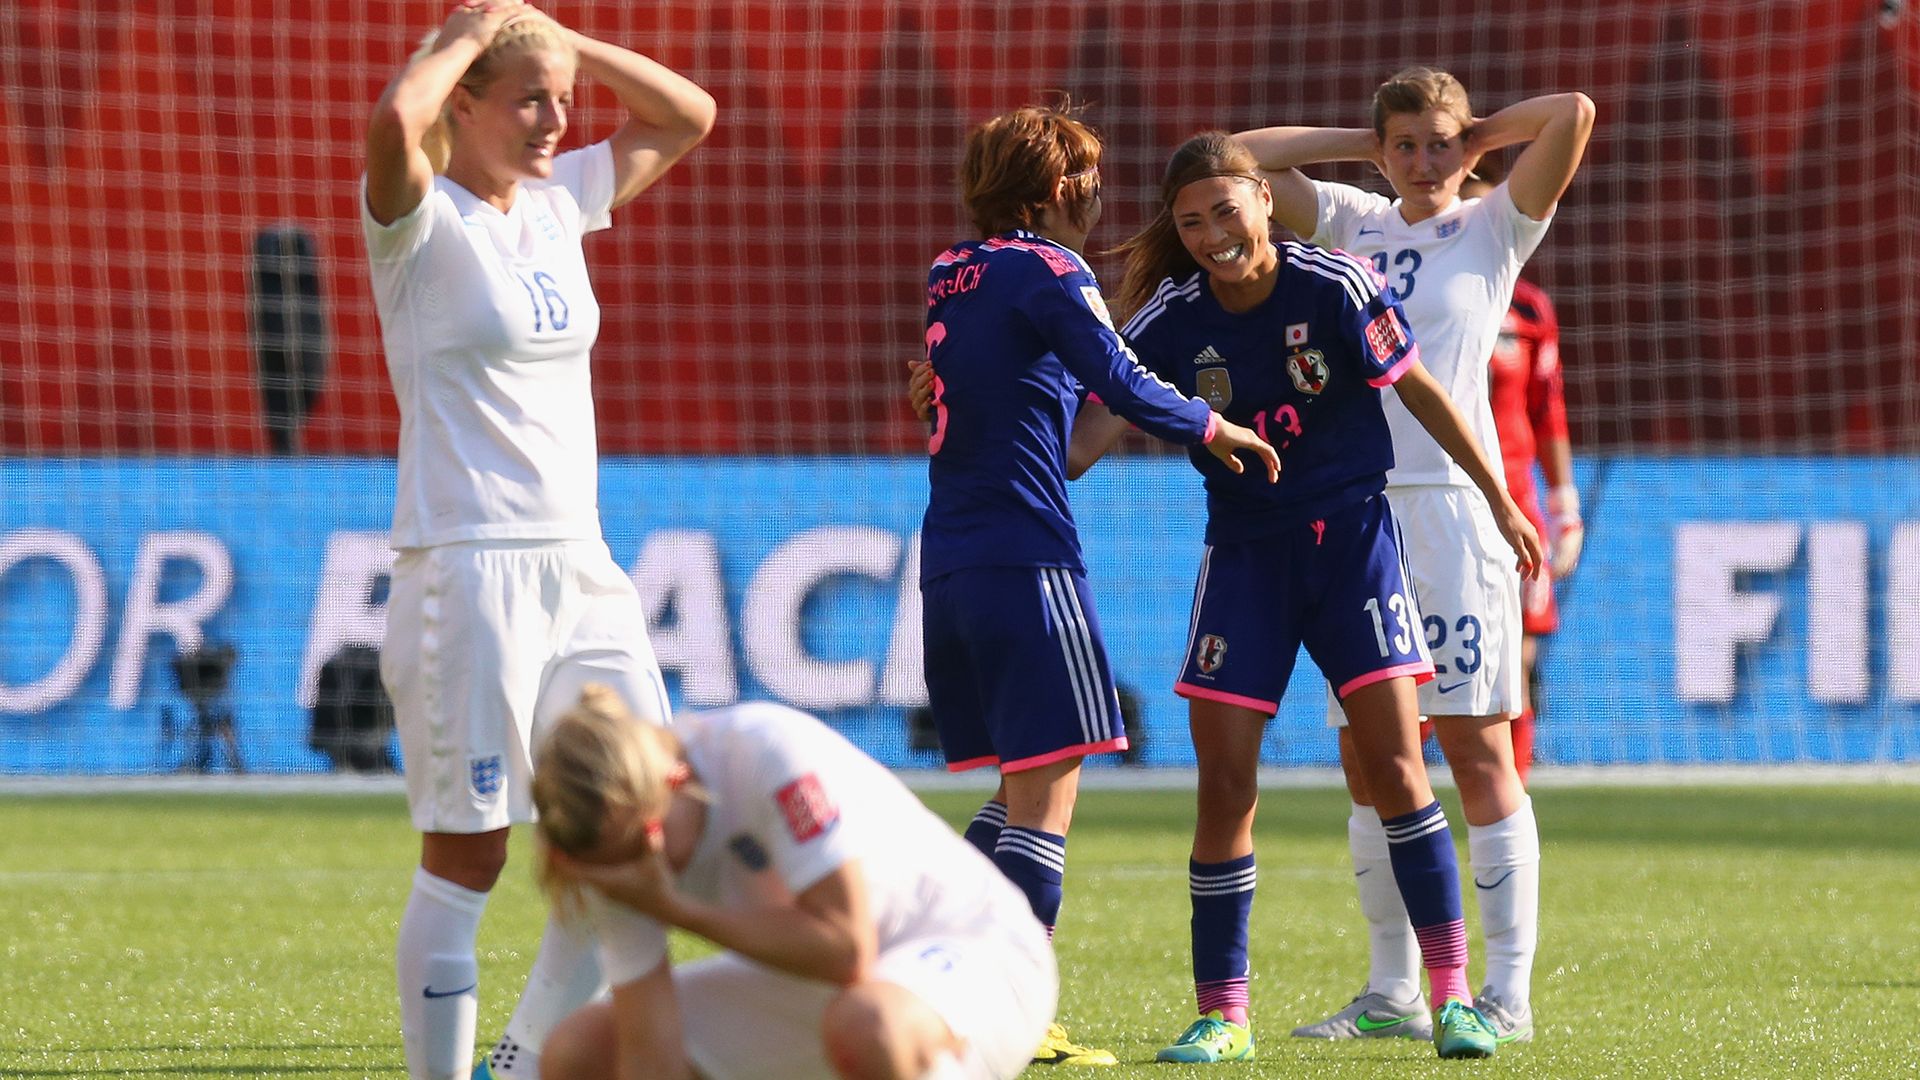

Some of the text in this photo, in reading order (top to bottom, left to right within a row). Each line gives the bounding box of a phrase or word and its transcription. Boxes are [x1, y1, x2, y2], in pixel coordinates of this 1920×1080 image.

[515, 271, 568, 332] 16
[1253, 403, 1302, 449] 13
[1363, 592, 1412, 658] 13
[1672, 520, 1920, 704] FI
[1423, 614, 1482, 675] 23
